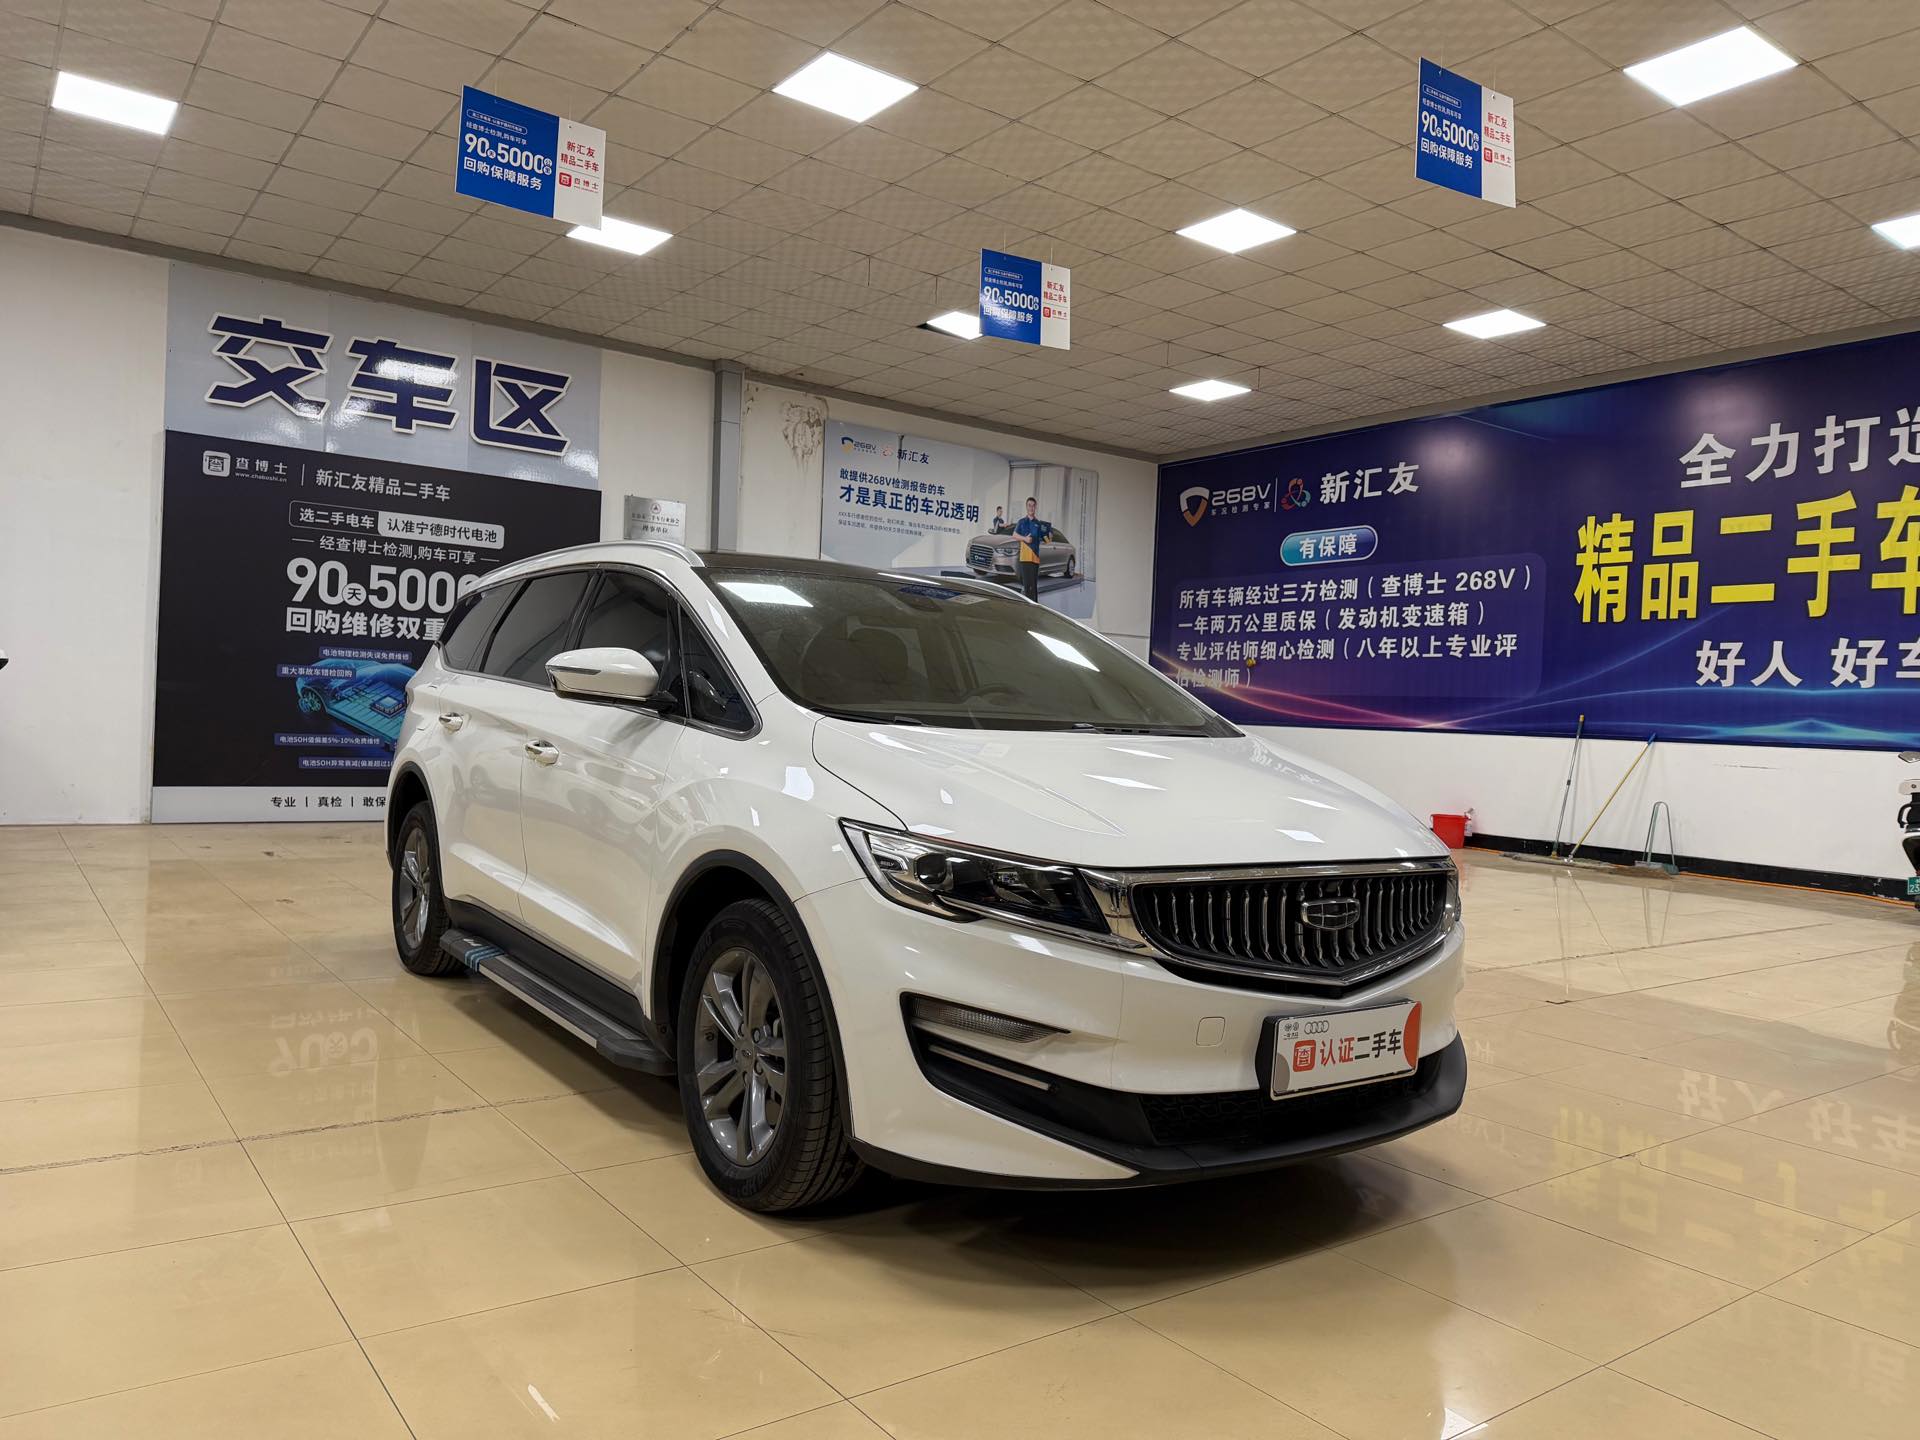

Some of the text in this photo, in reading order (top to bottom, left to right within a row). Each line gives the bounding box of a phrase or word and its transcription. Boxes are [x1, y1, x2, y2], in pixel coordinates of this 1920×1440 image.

[560, 153, 600, 173] 精品二手车
[566, 141, 596, 159] 新汇友
[1421, 137, 1473, 169] 回购保障服务
[464, 156, 542, 190] 回购保障服务
[205, 312, 572, 456] 交车区
[235, 457, 288, 475] 查博士
[896, 449, 930, 465] 新汇友
[315, 468, 451, 502] 新汇友精品二手车
[839, 468, 945, 496] 敢提供268V检测报告的车
[1211, 483, 1271, 506] 268V
[1319, 461, 1420, 505] 新汇友
[839, 484, 979, 523] 才是真正的车况透明
[299, 507, 497, 543] 选二手电车 认准宁德时代电池
[1299, 532, 1358, 560] 有保障
[1573, 484, 1920, 623] 精品二手车
[285, 606, 445, 641] 回购维修双重
[1696, 640, 1803, 688] 好人
[270, 796, 386, 808] 专业 真检 敢保
[1319, 1028, 1402, 1067] 认证二手车
